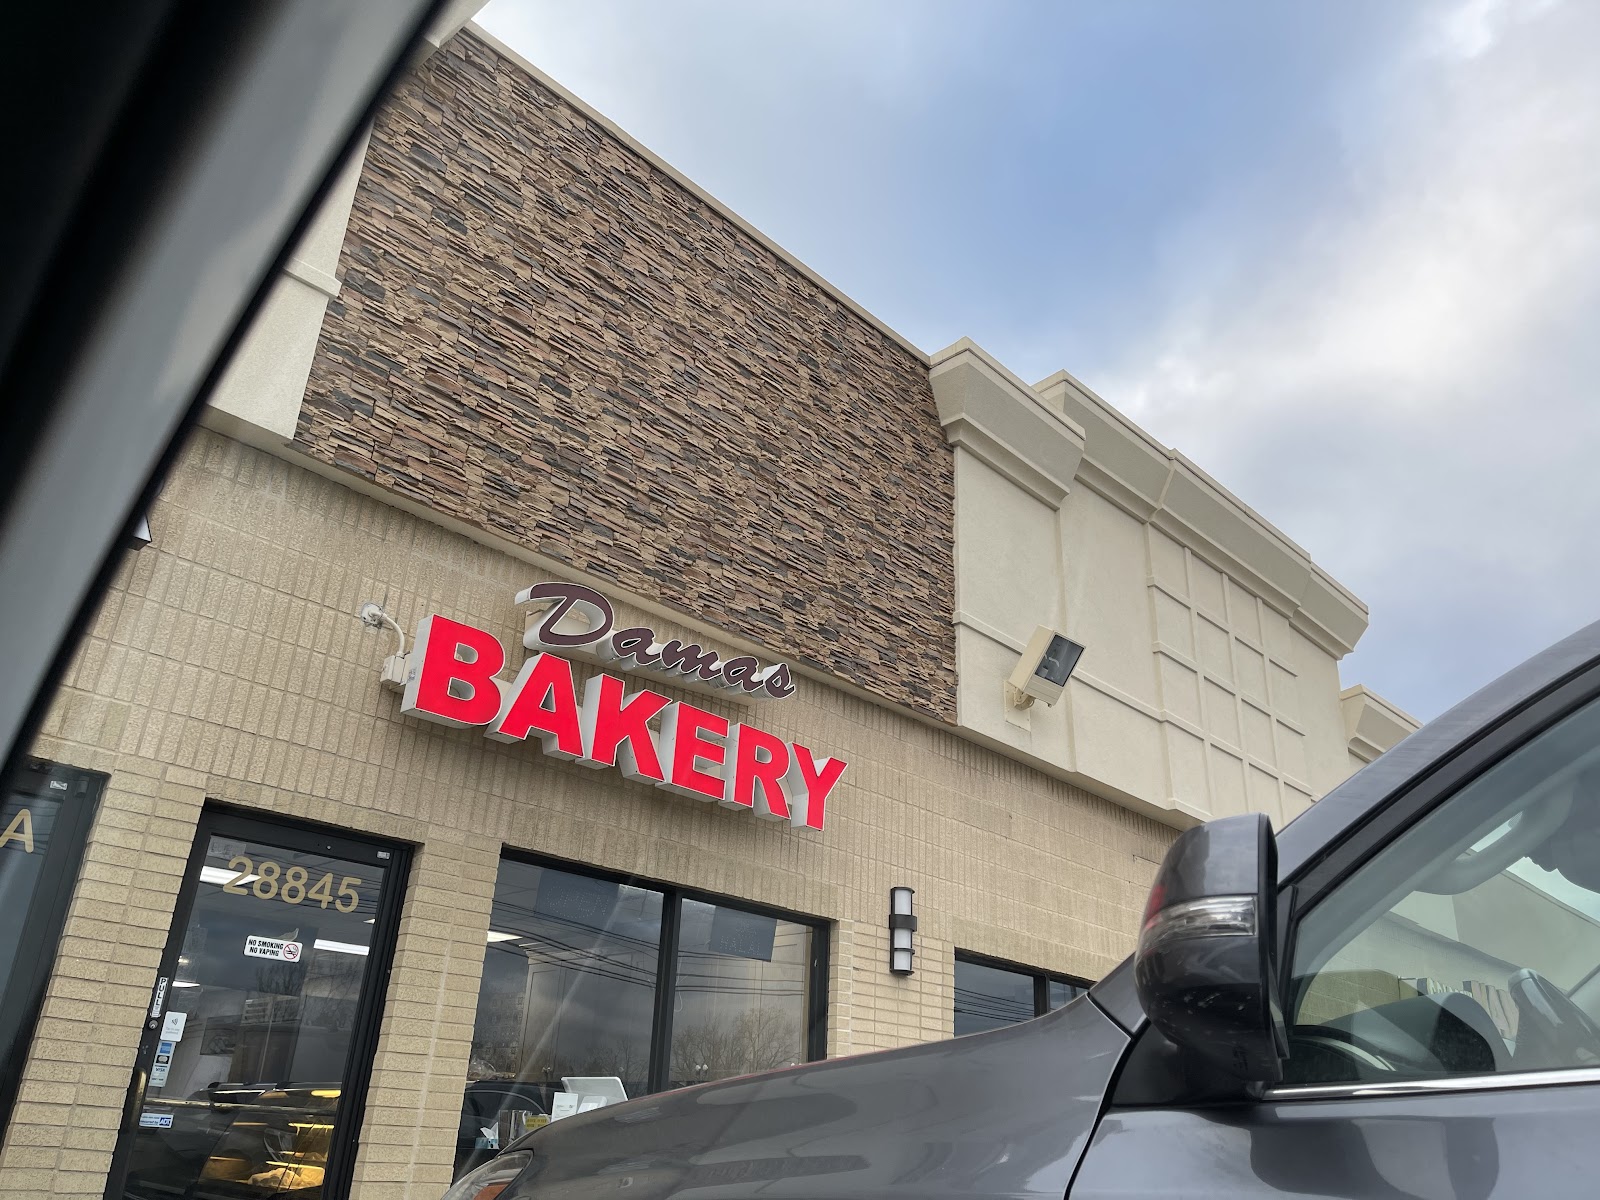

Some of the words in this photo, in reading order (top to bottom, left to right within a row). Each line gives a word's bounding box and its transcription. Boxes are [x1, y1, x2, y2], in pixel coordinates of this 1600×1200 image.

[526, 581, 796, 700] Damas
[414, 613, 848, 831] BAKERY
[0, 808, 34, 853] A
[222, 855, 362, 914] 28845
[257, 940, 284, 950] SMOKING
[259, 948, 280, 957] VAPING
[155, 978, 167, 1006] PULL
